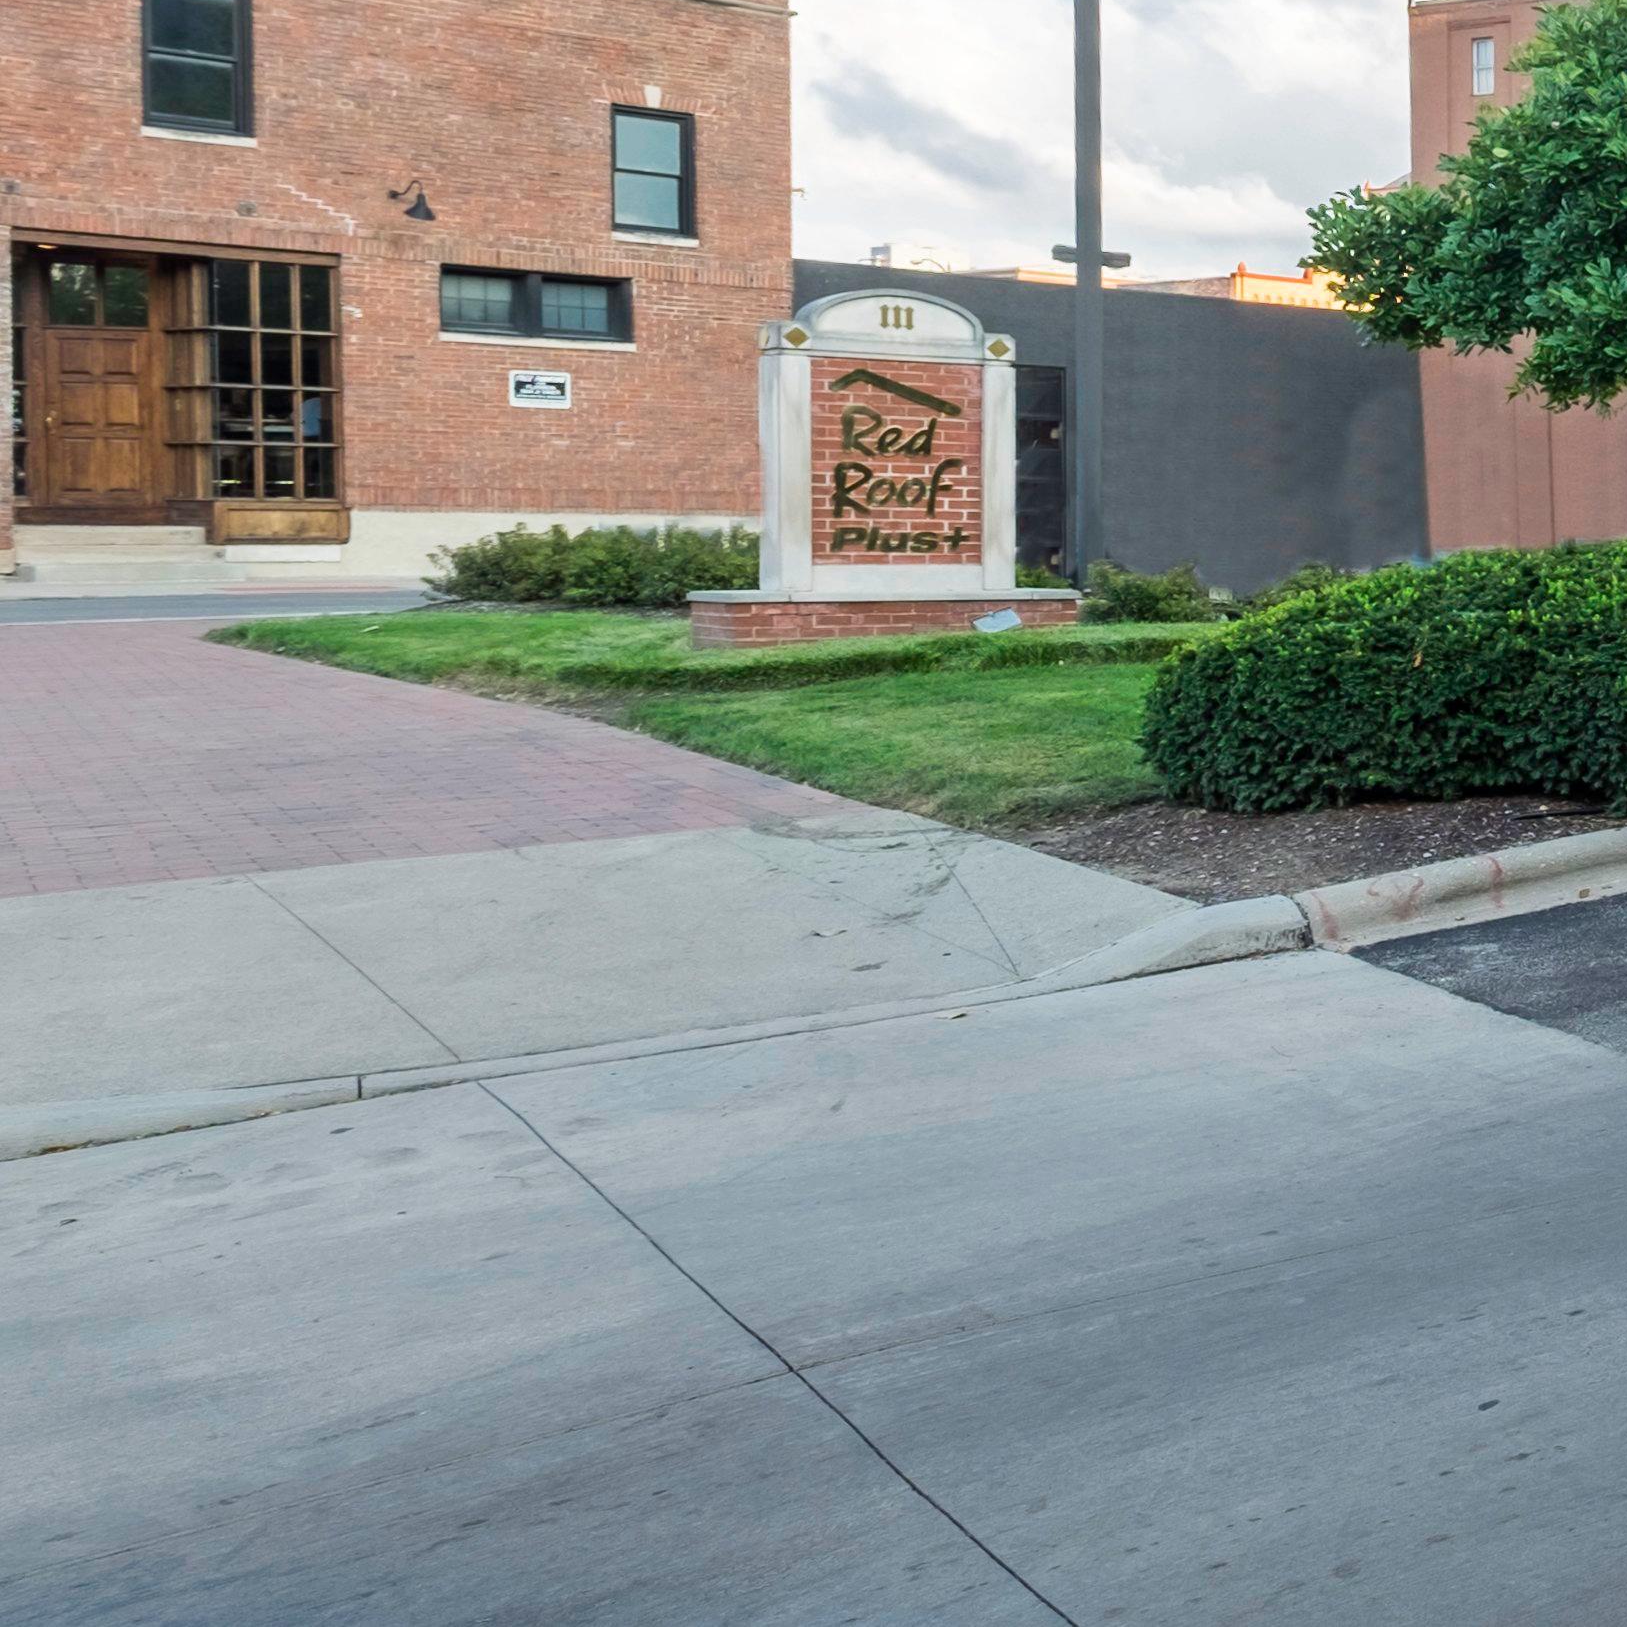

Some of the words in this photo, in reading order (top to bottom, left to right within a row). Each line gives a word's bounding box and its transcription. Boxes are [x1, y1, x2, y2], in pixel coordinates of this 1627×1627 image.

[841, 405, 937, 457] Red
[832, 458, 963, 518] Roof
[830, 526, 970, 553] Plus+
